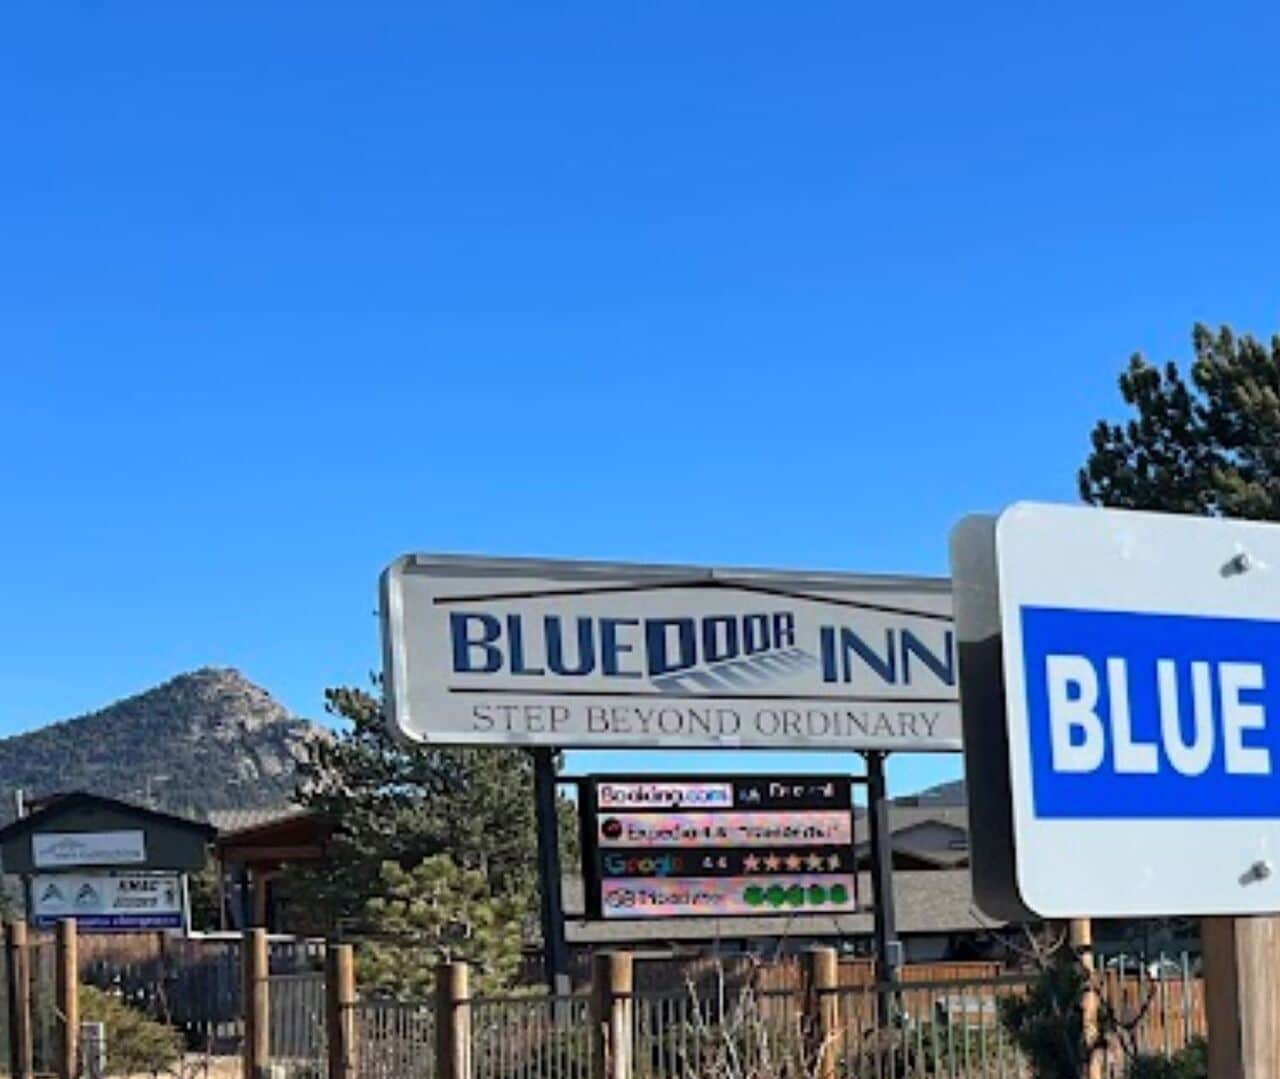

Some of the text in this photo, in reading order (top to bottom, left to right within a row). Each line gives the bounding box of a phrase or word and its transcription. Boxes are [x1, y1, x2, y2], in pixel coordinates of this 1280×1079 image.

[820, 625, 957, 687] INN
[472, 704, 943, 738] STEP BEYOND ORDINARY
[1046, 653, 1272, 777] BLUE
[601, 785, 729, 807] Booking.com
[605, 853, 684, 877] Google
